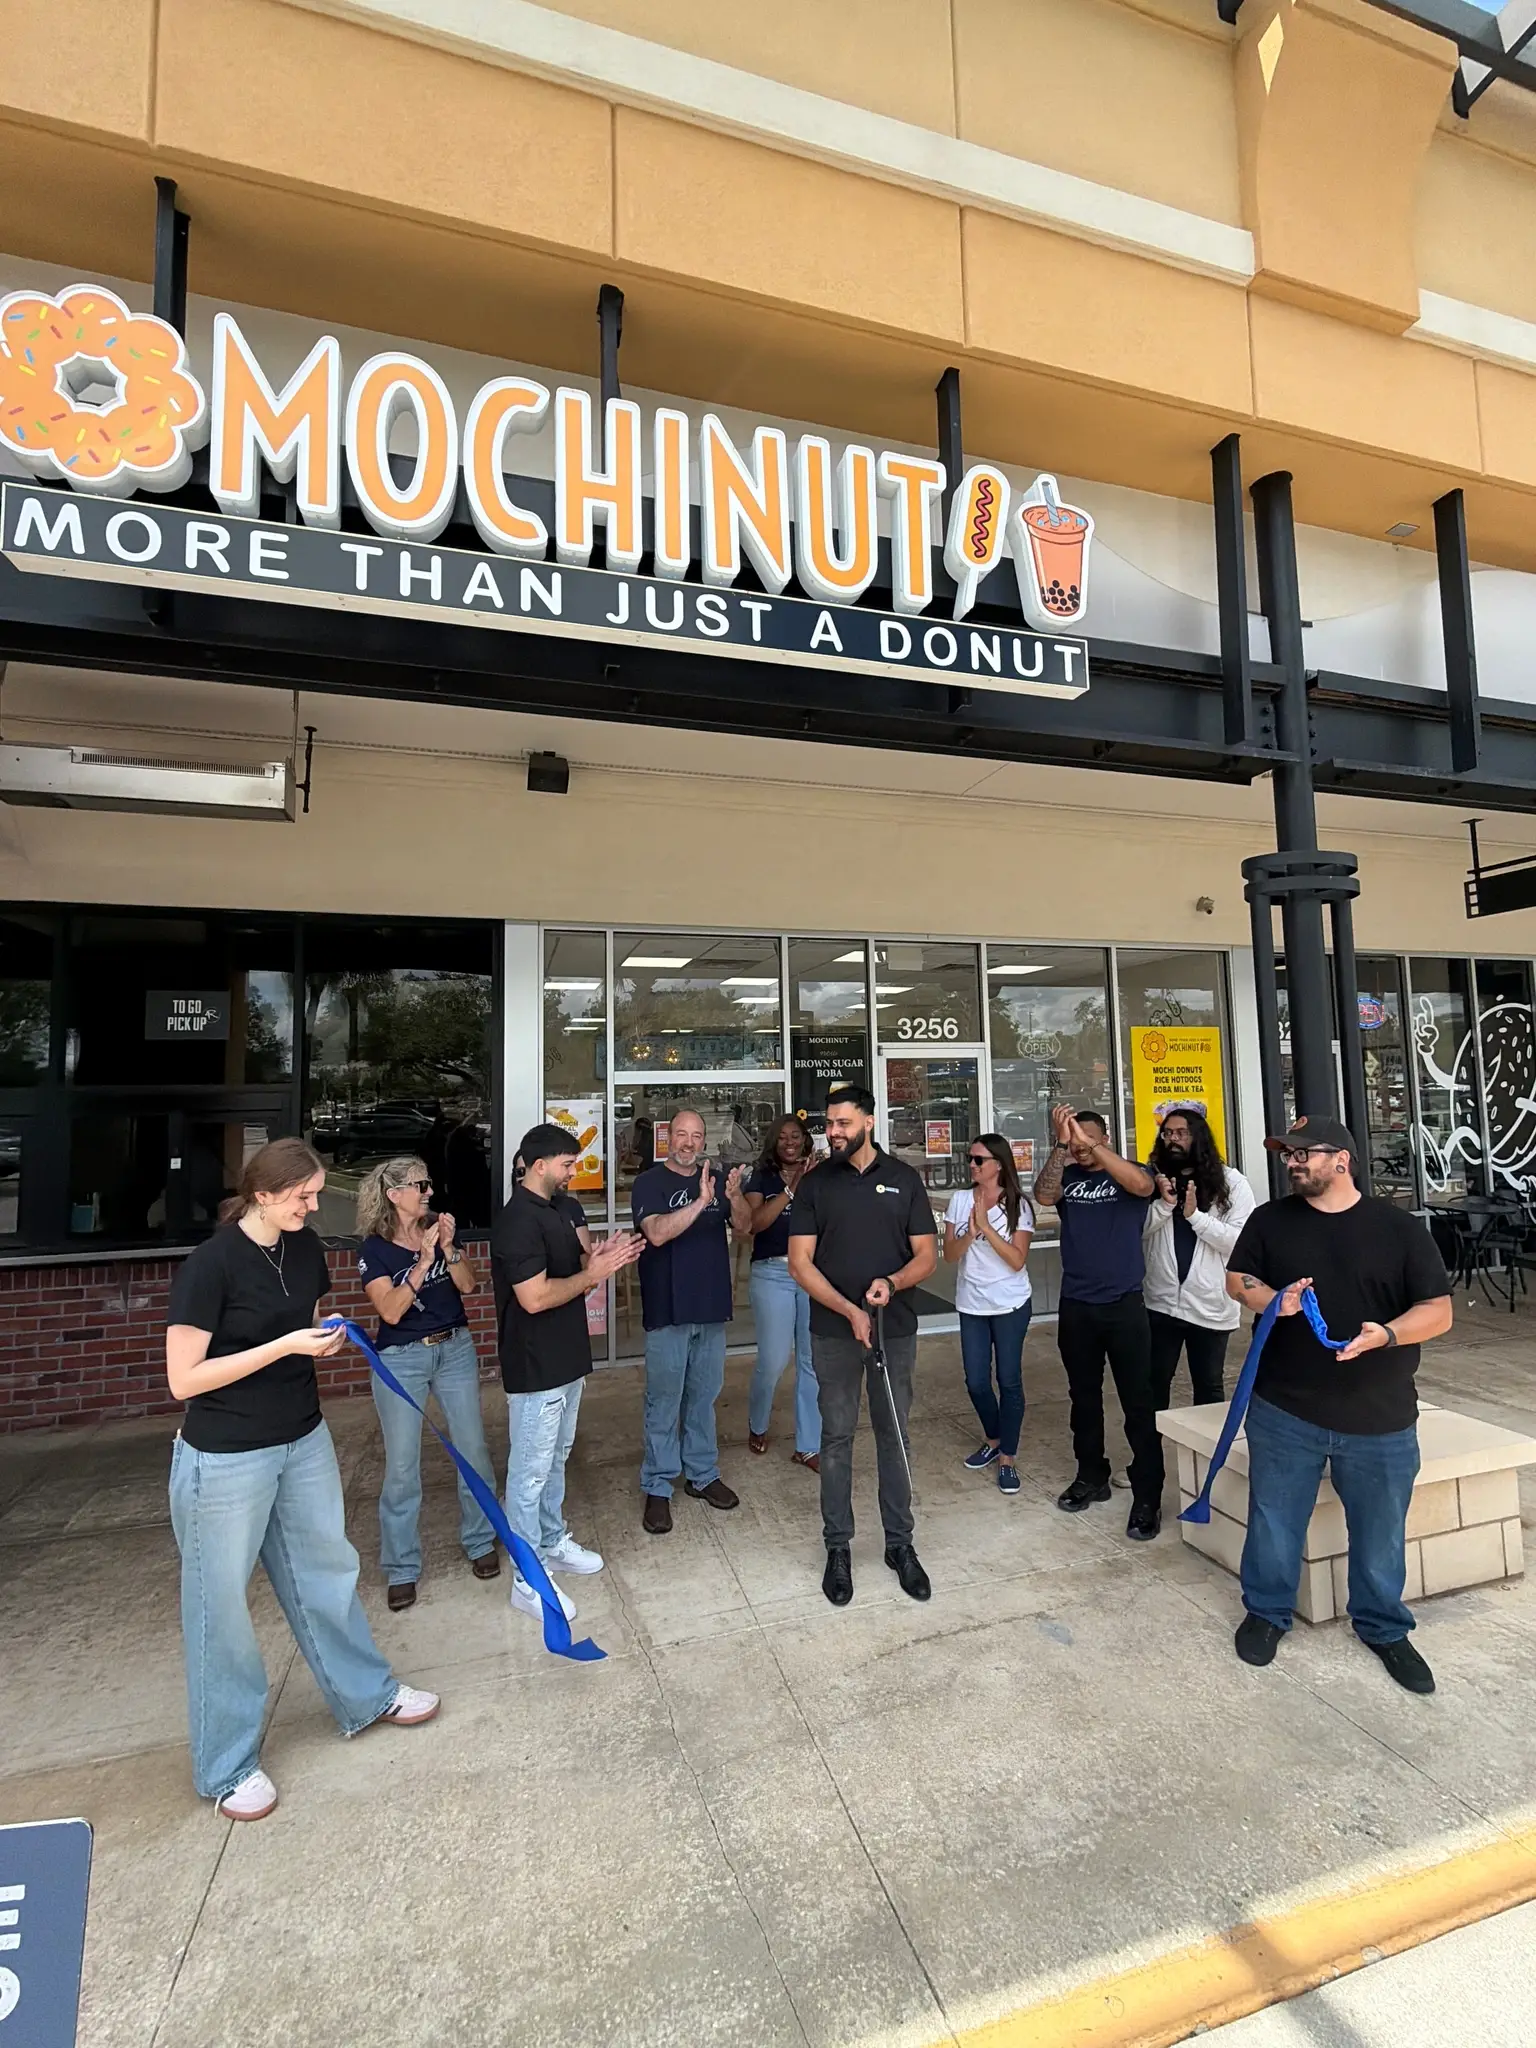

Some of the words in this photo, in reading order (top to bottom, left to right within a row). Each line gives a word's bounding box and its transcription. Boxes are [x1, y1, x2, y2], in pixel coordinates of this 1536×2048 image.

[209, 312, 946, 611] MOCHINUT
[13, 497, 291, 581] MORE
[340, 542, 565, 617] THAN
[605, 580, 773, 643] JUST
[809, 609, 844, 653] A
[880, 620, 1082, 683] DONUT
[172, 999, 186, 1014] TO
[187, 999, 202, 1014] GO
[166, 1016, 191, 1031] PICK
[192, 1016, 207, 1031] UP
[897, 1017, 959, 1040] 3256
[1024, 1042, 1054, 1054] OPEN
[1169, 1042, 1200, 1052] MOCHINUT
[794, 1059, 830, 1068] BROWN
[832, 1058, 864, 1068] SUGAR
[816, 1069, 843, 1078] BOBA
[1152, 1066, 1175, 1074] MOCHI
[1176, 1066, 1203, 1074] DONUTS
[1154, 1076, 1170, 1084] RICE
[1171, 1076, 1202, 1084] HOTDOGS
[1153, 1085, 1172, 1094] BOBA
[1173, 1085, 1190, 1093] MILK
[1191, 1085, 1204, 1093] TEA
